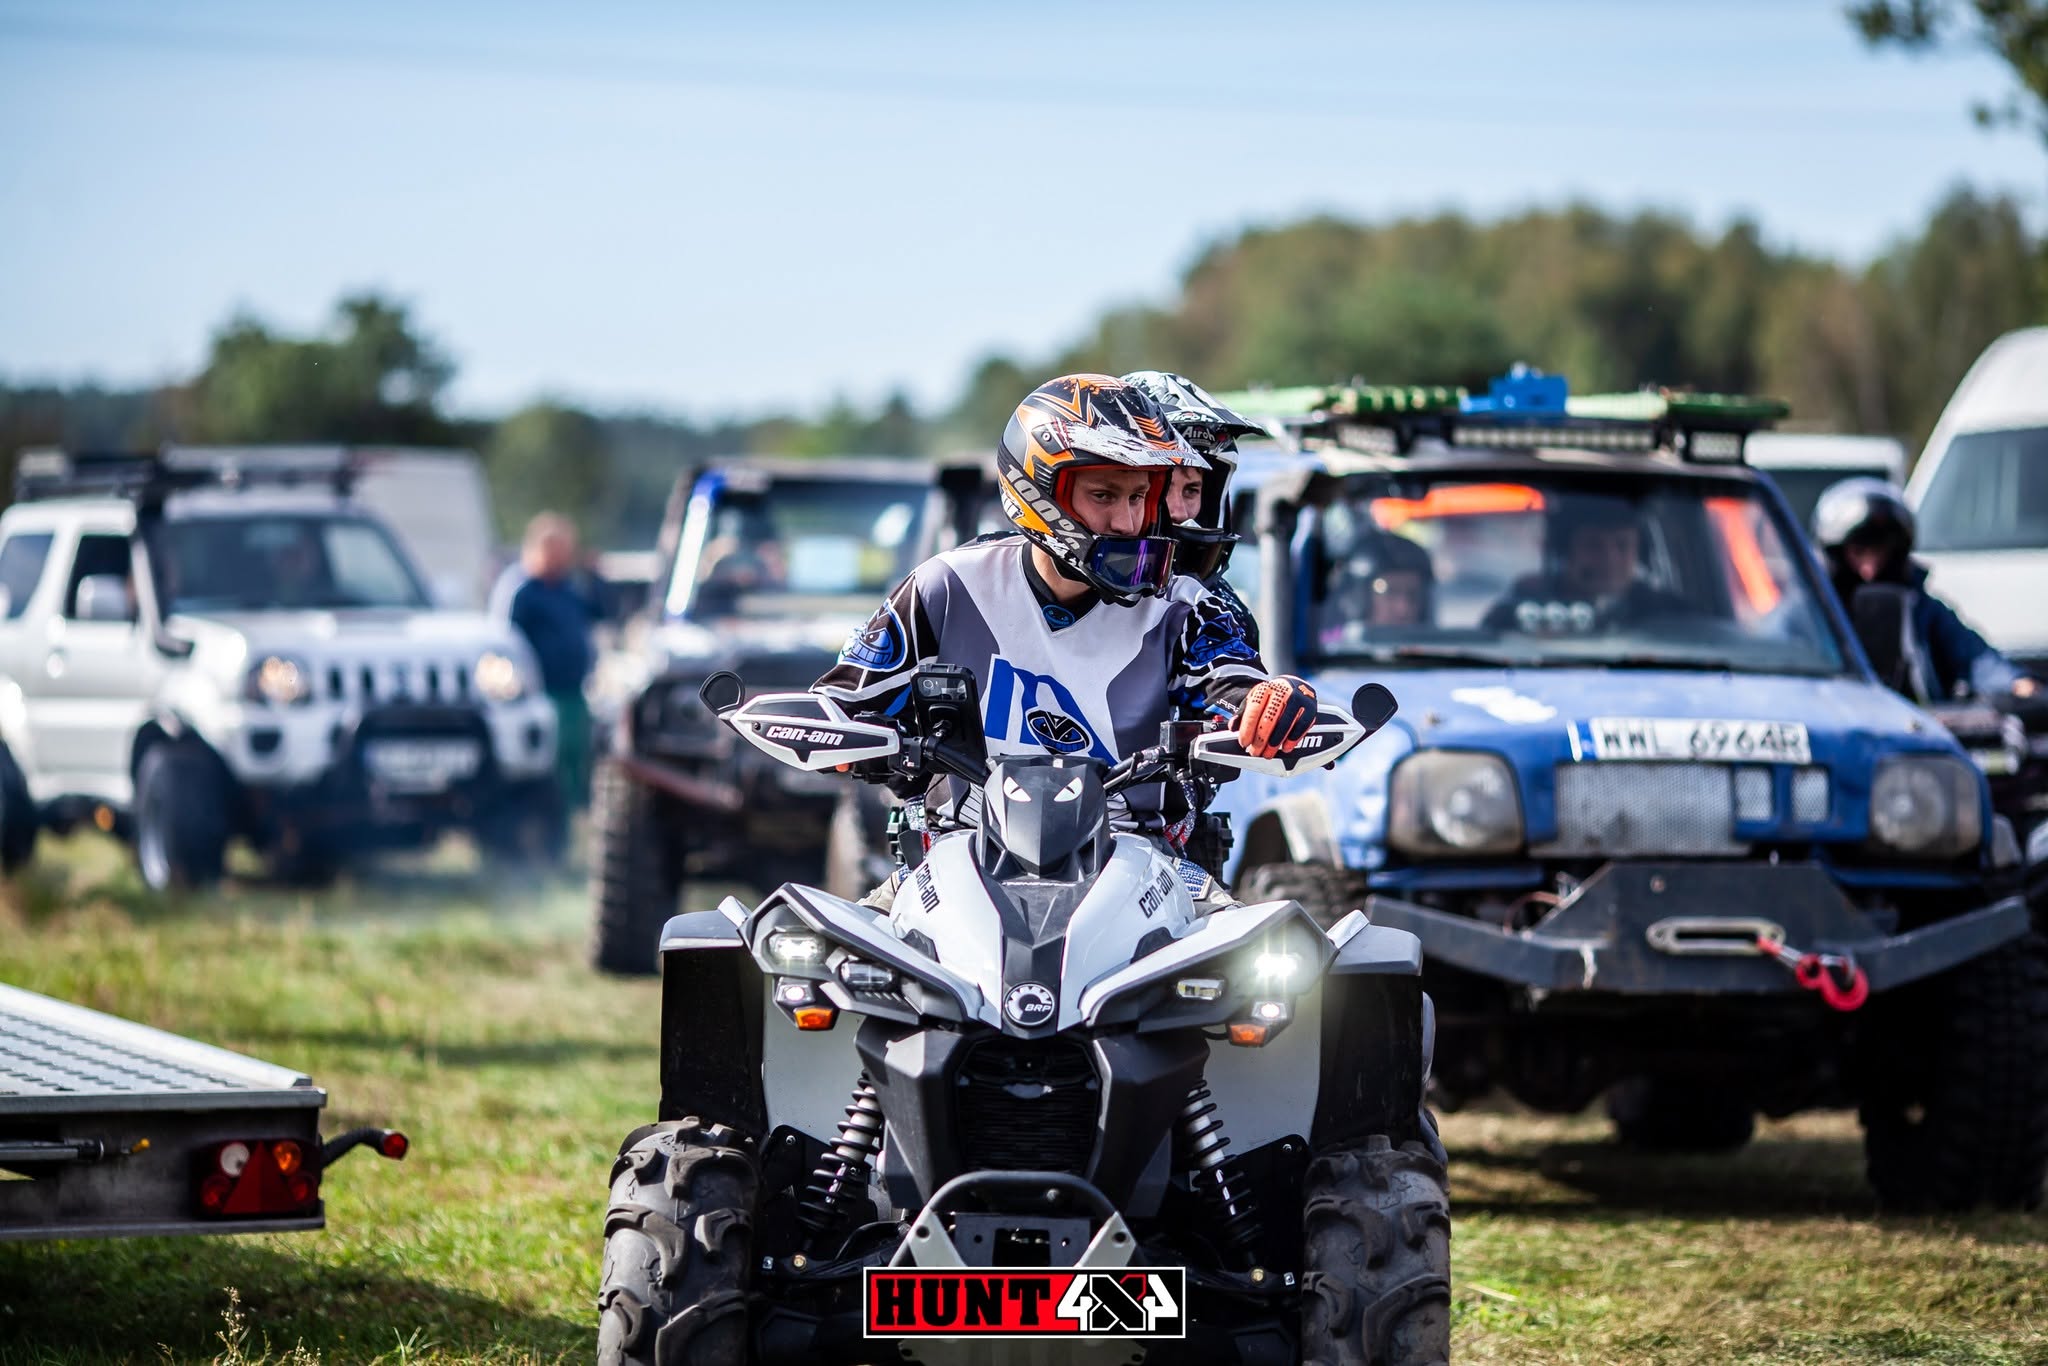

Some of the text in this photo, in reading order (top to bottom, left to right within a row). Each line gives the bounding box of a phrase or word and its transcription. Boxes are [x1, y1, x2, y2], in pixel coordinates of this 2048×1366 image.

[1182, 426, 1216, 442] Airoh
[1006, 464, 1086, 550] 100%
[766, 725, 844, 746] can-am
[1689, 720, 1802, 759] 6964R
[915, 863, 940, 914] can-am
[1138, 868, 1175, 919] can-am
[1024, 1003, 1052, 1012] BRP
